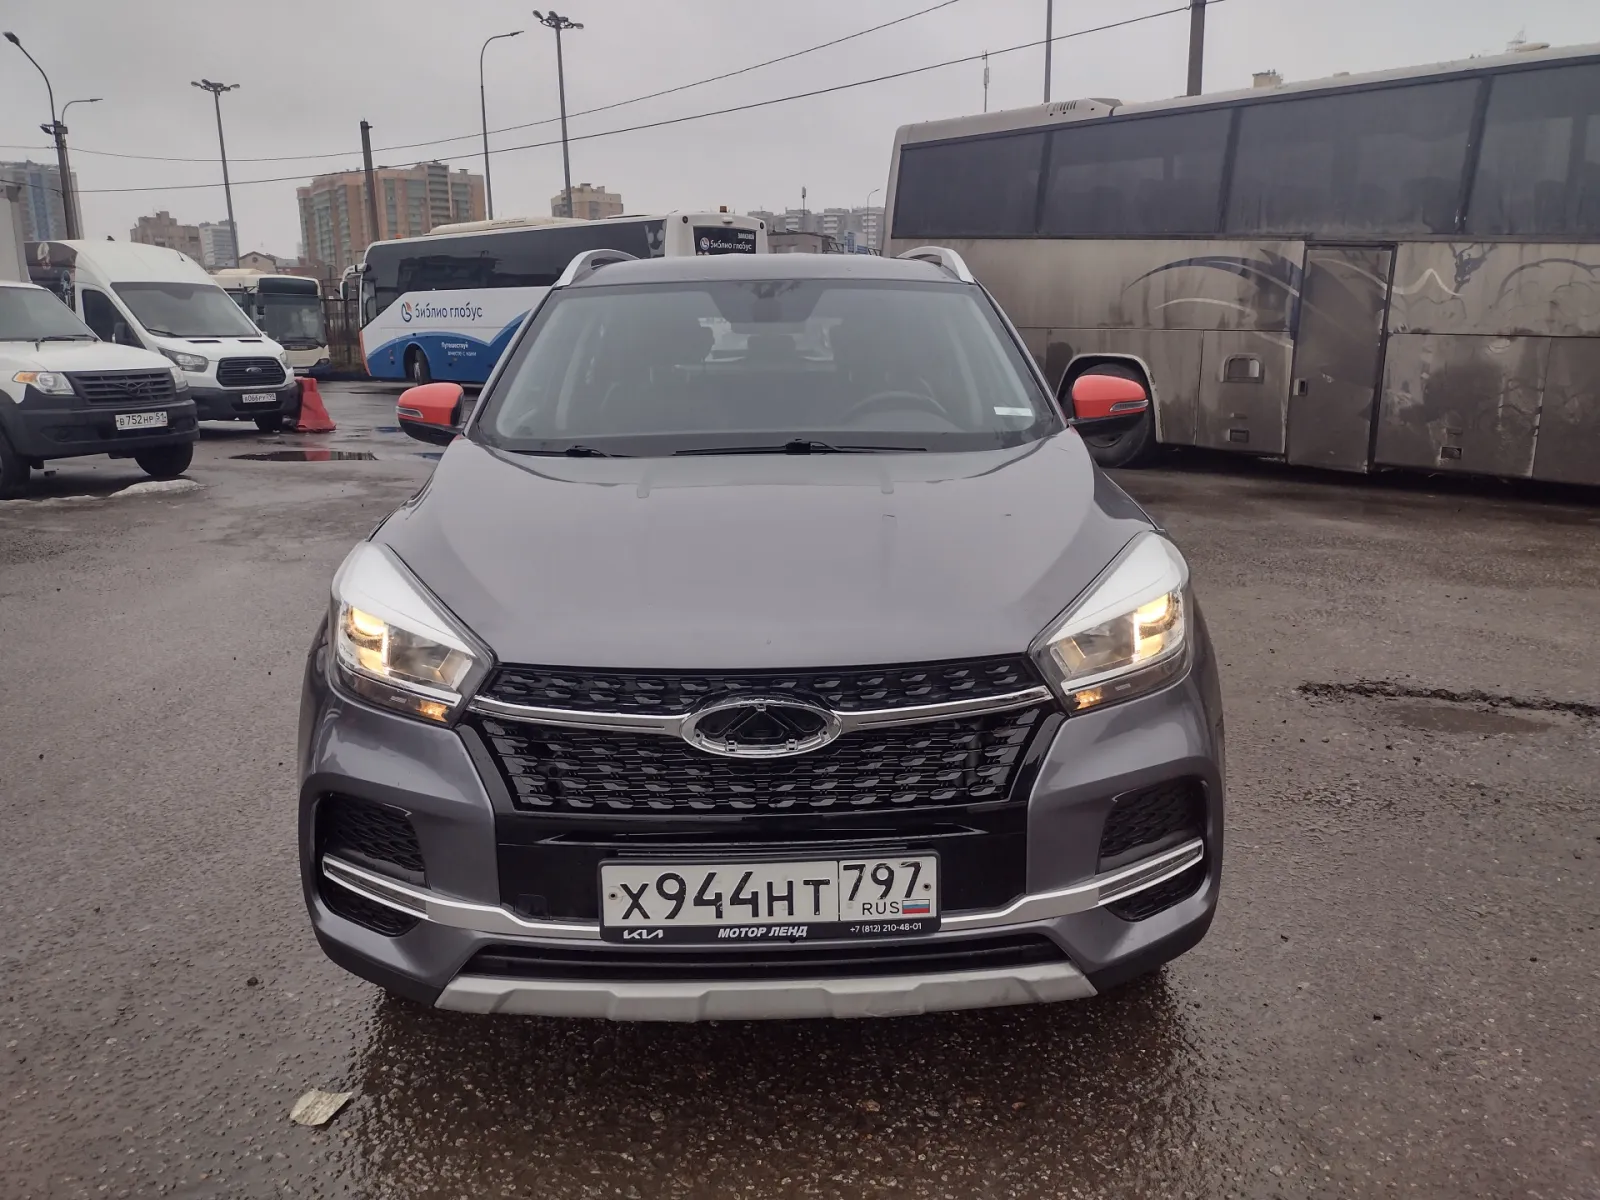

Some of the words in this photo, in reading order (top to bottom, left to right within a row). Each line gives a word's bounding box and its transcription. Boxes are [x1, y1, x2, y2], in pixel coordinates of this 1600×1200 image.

[415, 303, 448, 318] библио
[449, 302, 483, 321] глобус
[842, 861, 922, 902] 797
[862, 901, 900, 916] RUS
[717, 927, 767, 938] МОТОР
[768, 925, 808, 938] ЛЕНД
[849, 925, 860, 934] +7
[861, 924, 881, 933] (812)
[882, 923, 922, 932] 210-48-01
